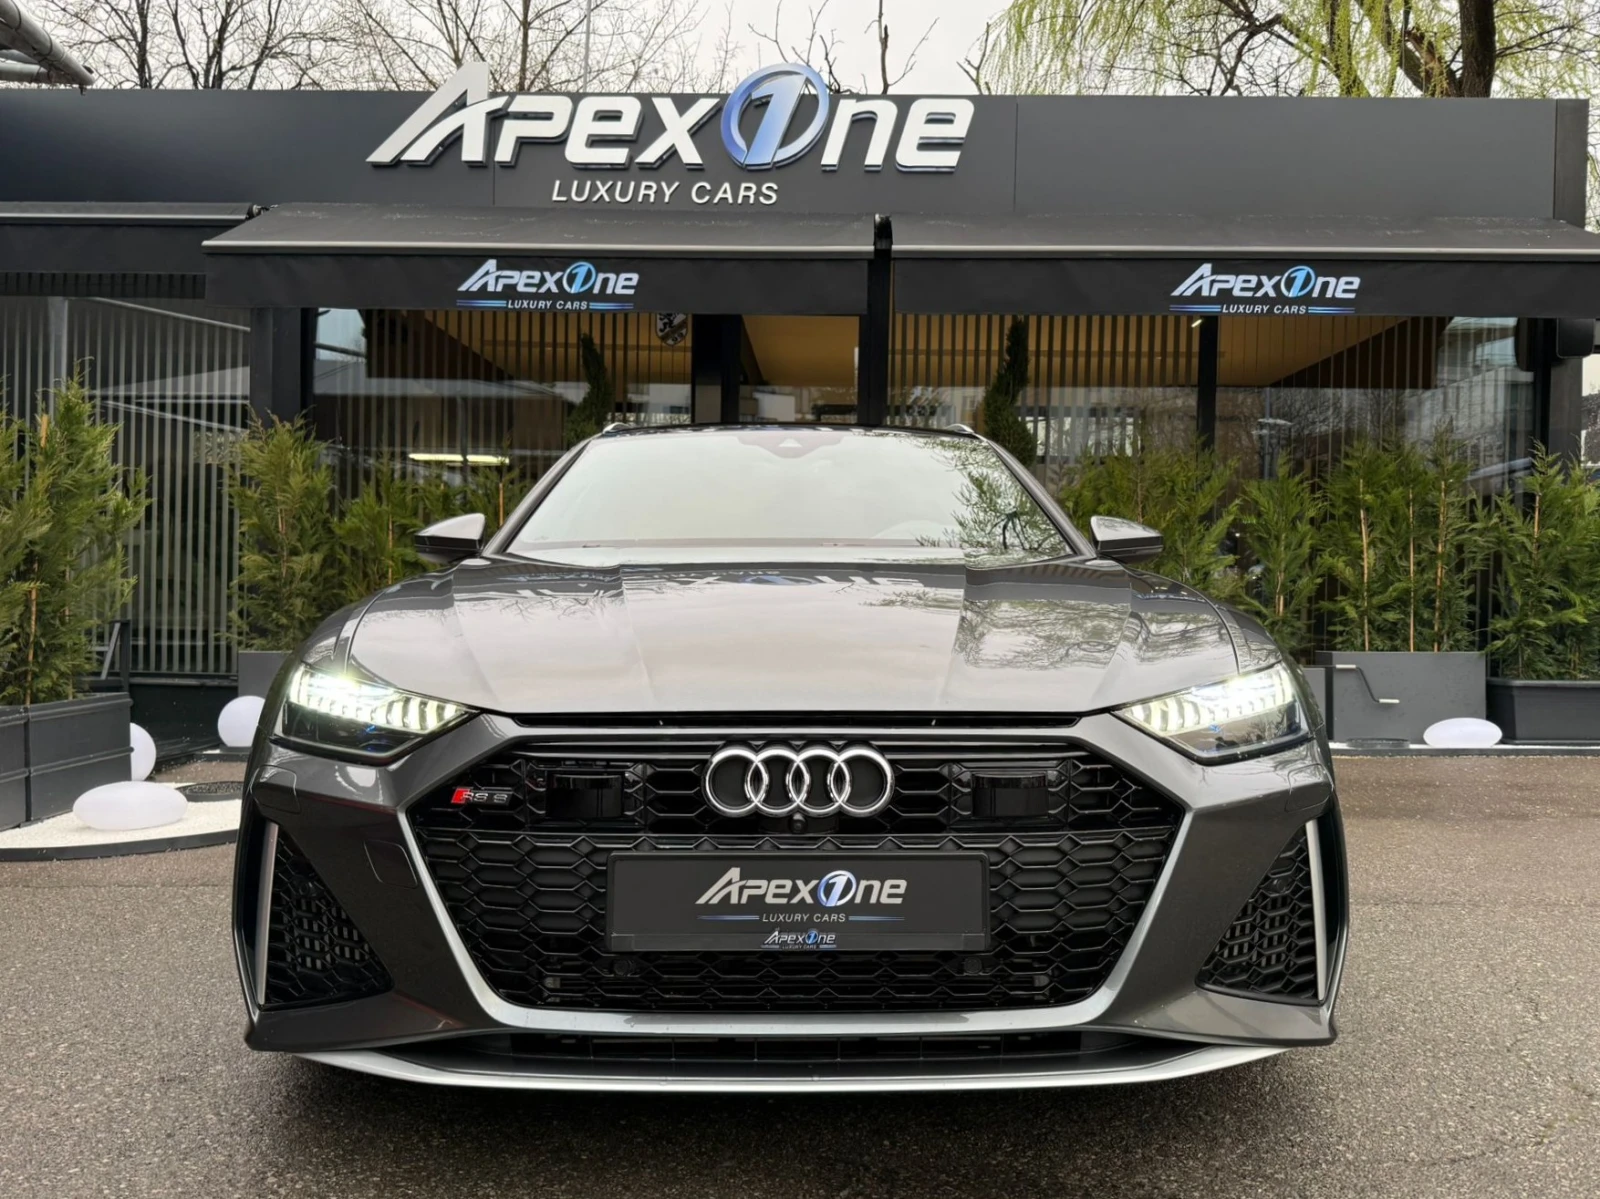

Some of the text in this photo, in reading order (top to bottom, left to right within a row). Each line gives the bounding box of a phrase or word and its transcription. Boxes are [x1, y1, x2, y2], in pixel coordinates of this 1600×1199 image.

[552, 180, 779, 205] LUXURY CARS
[507, 299, 588, 310] LUXURY CARS
[1222, 304, 1307, 315] LUXURY CARS
[762, 913, 846, 923] LUXURY CARS
